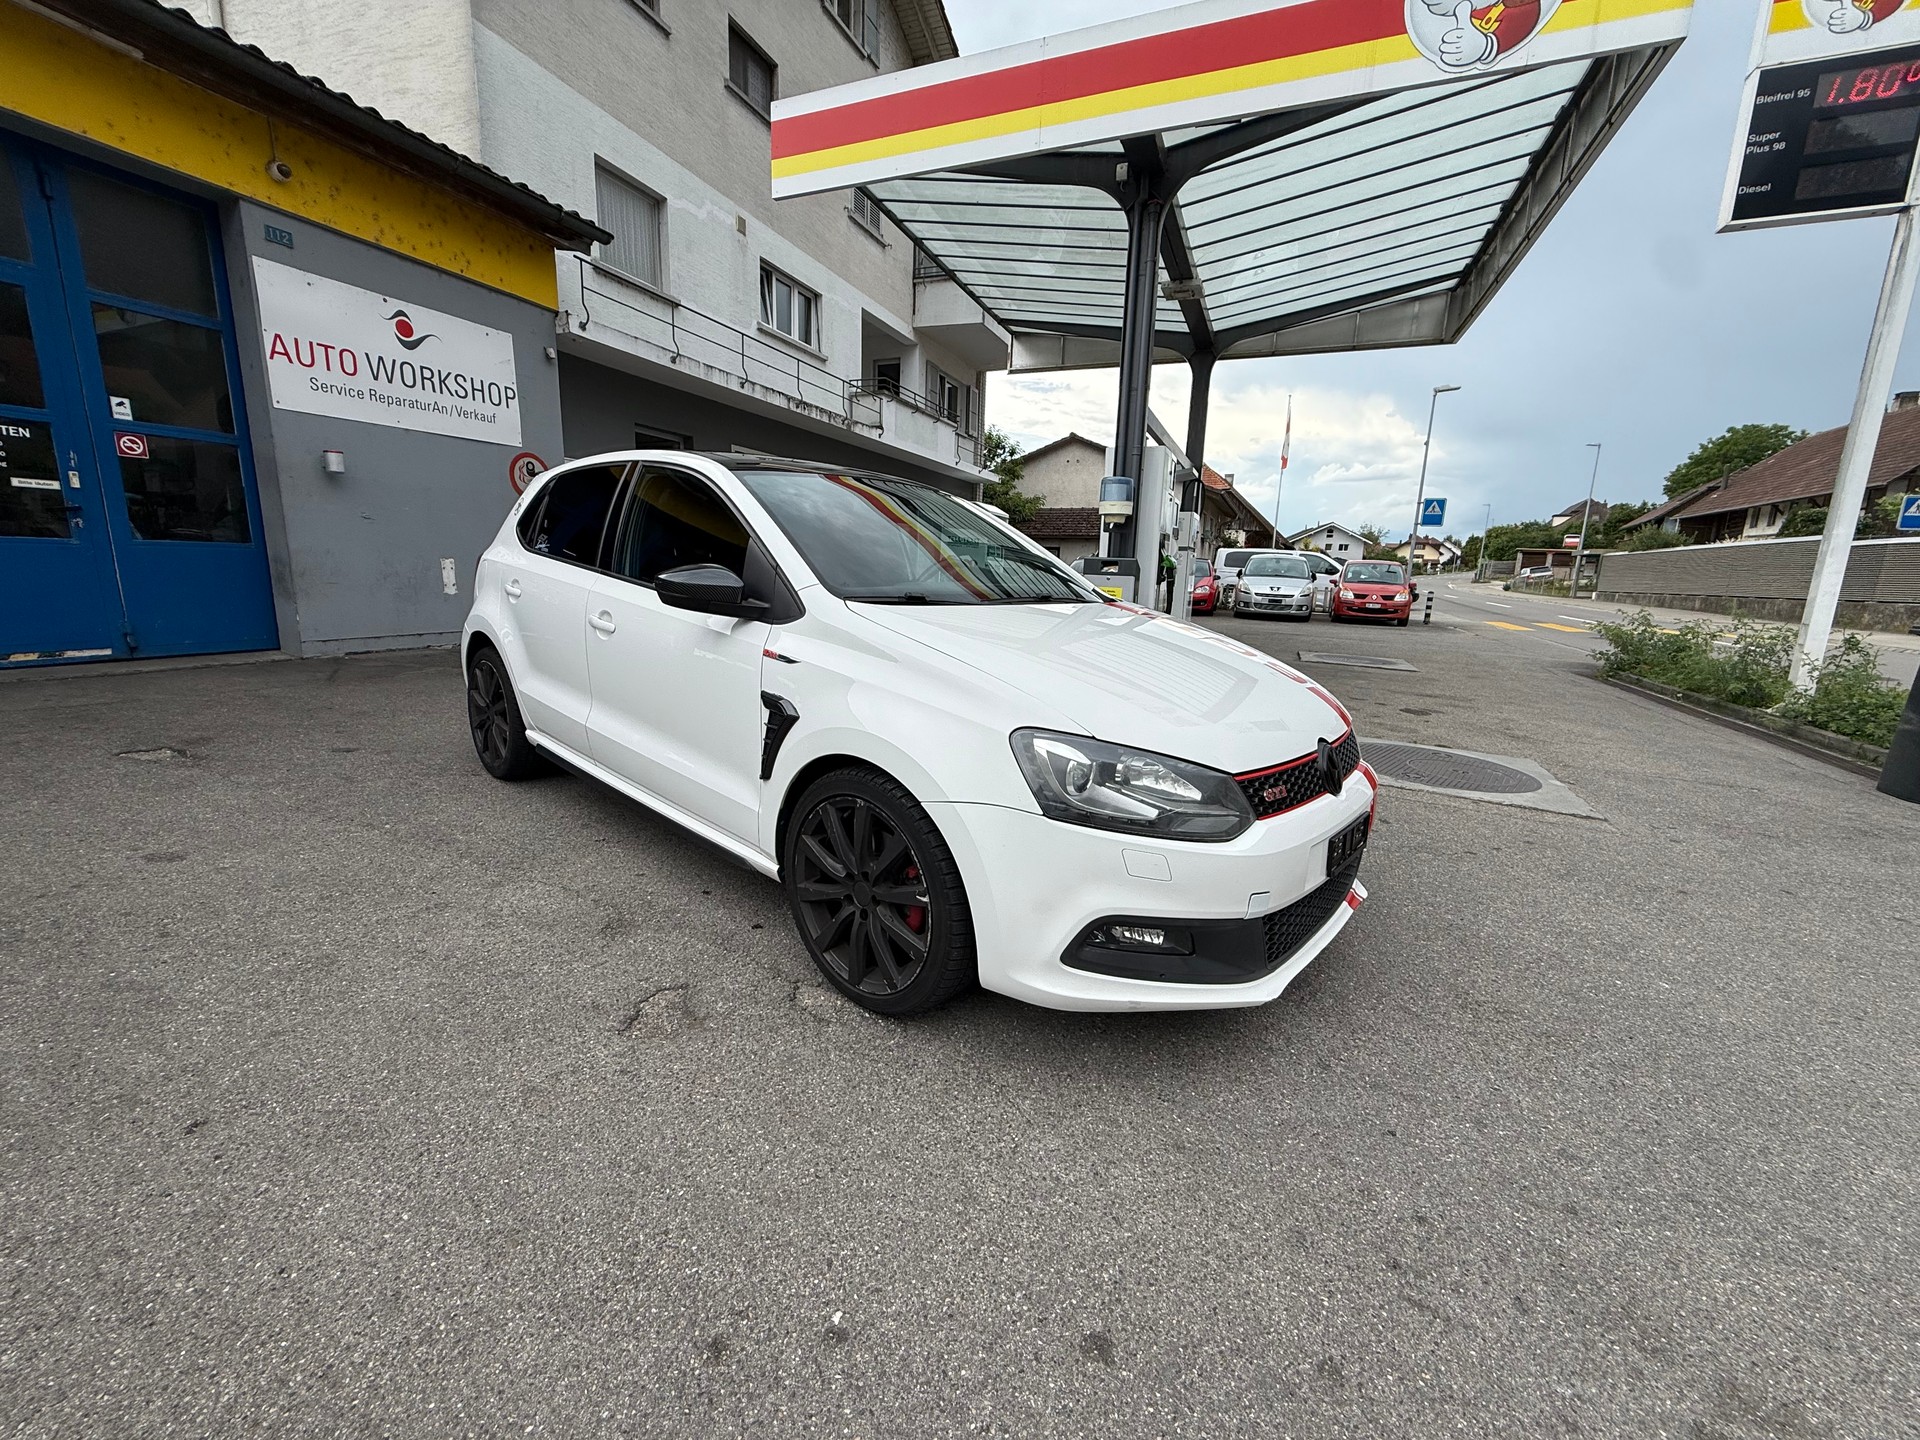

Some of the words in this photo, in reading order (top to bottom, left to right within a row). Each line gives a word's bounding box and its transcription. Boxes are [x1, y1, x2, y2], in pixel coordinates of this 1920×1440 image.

[1756, 90, 1795, 105] Bleifrei
[1797, 88, 1811, 98] 95
[1748, 131, 1781, 143] Super
[1746, 145, 1770, 155] Plus
[1772, 141, 1786, 151] 98
[1738, 183, 1772, 195] Diesel
[269, 228, 290, 244] 112
[269, 333, 358, 377] AUTO
[364, 352, 517, 409] WORKSHOP
[309, 377, 365, 399] Service
